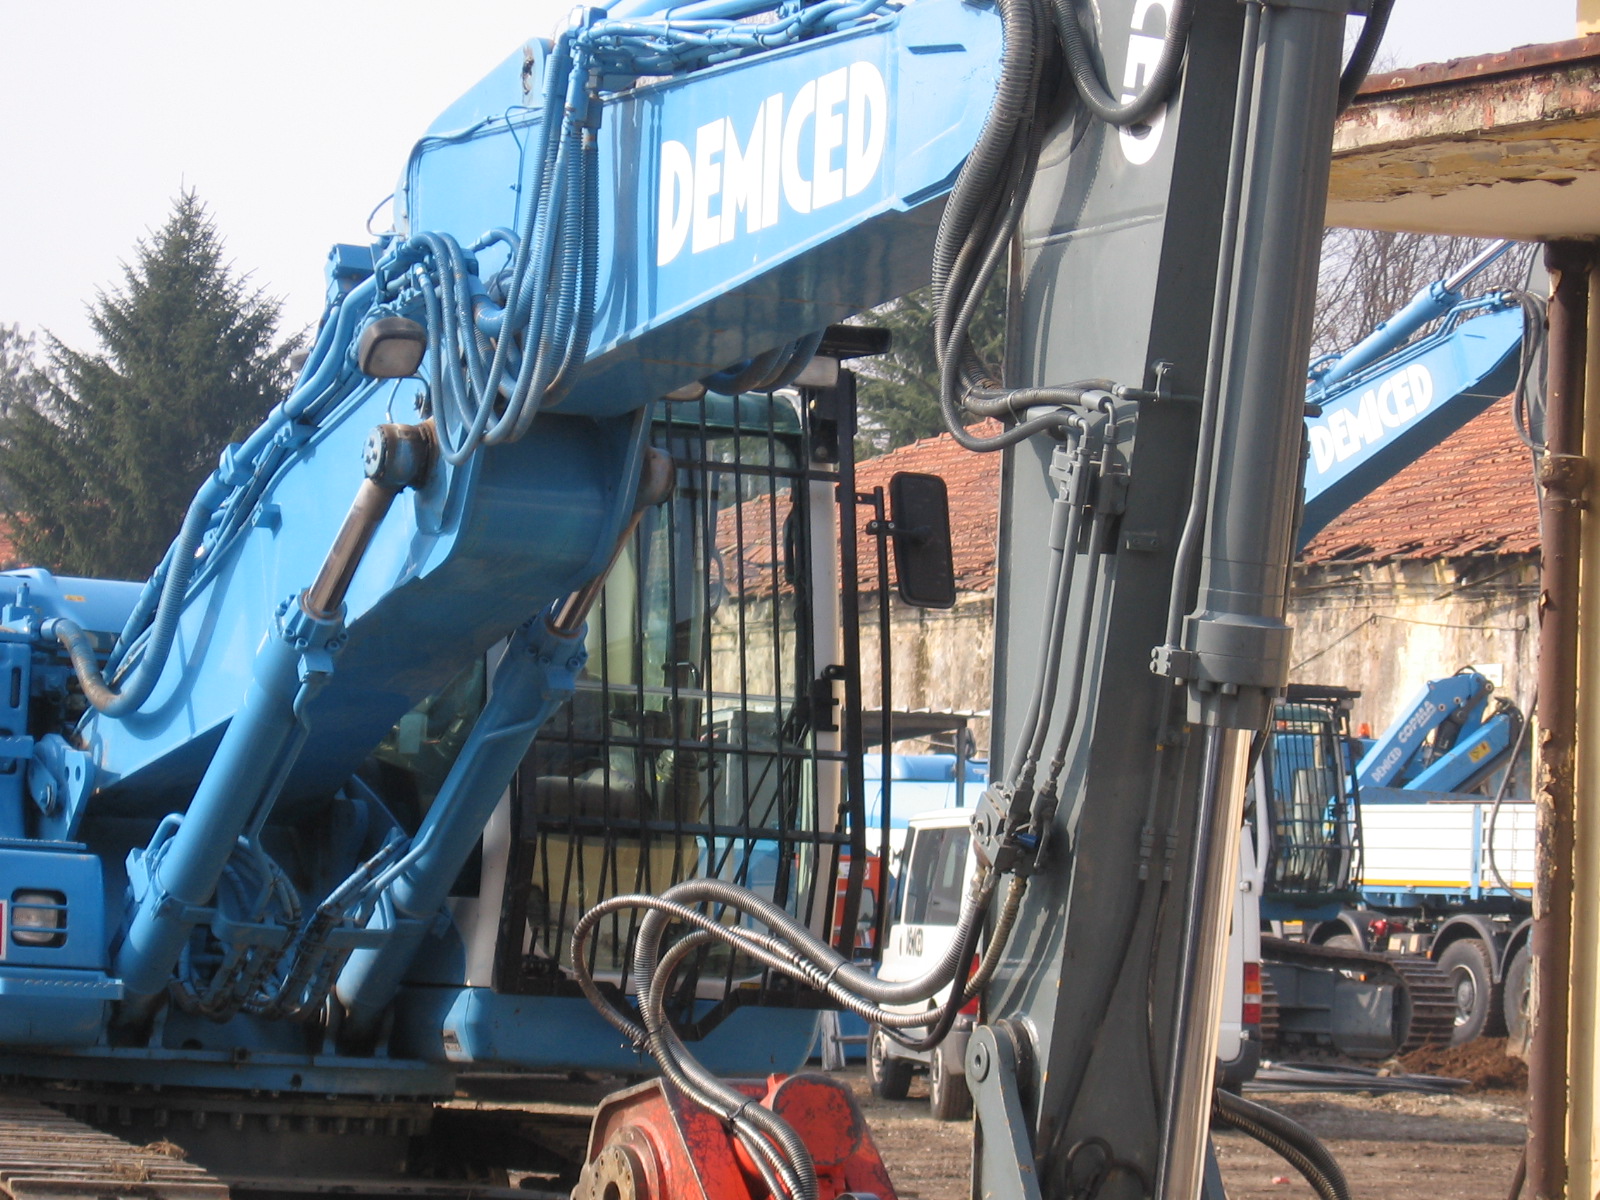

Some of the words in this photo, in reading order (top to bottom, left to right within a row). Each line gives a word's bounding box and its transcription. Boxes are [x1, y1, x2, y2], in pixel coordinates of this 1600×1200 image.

[657, 61, 887, 266] DEMICED
[1309, 363, 1433, 474] DEMICED
[1399, 701, 1436, 743] COPMA
[1372, 748, 1402, 782] DEMICED
